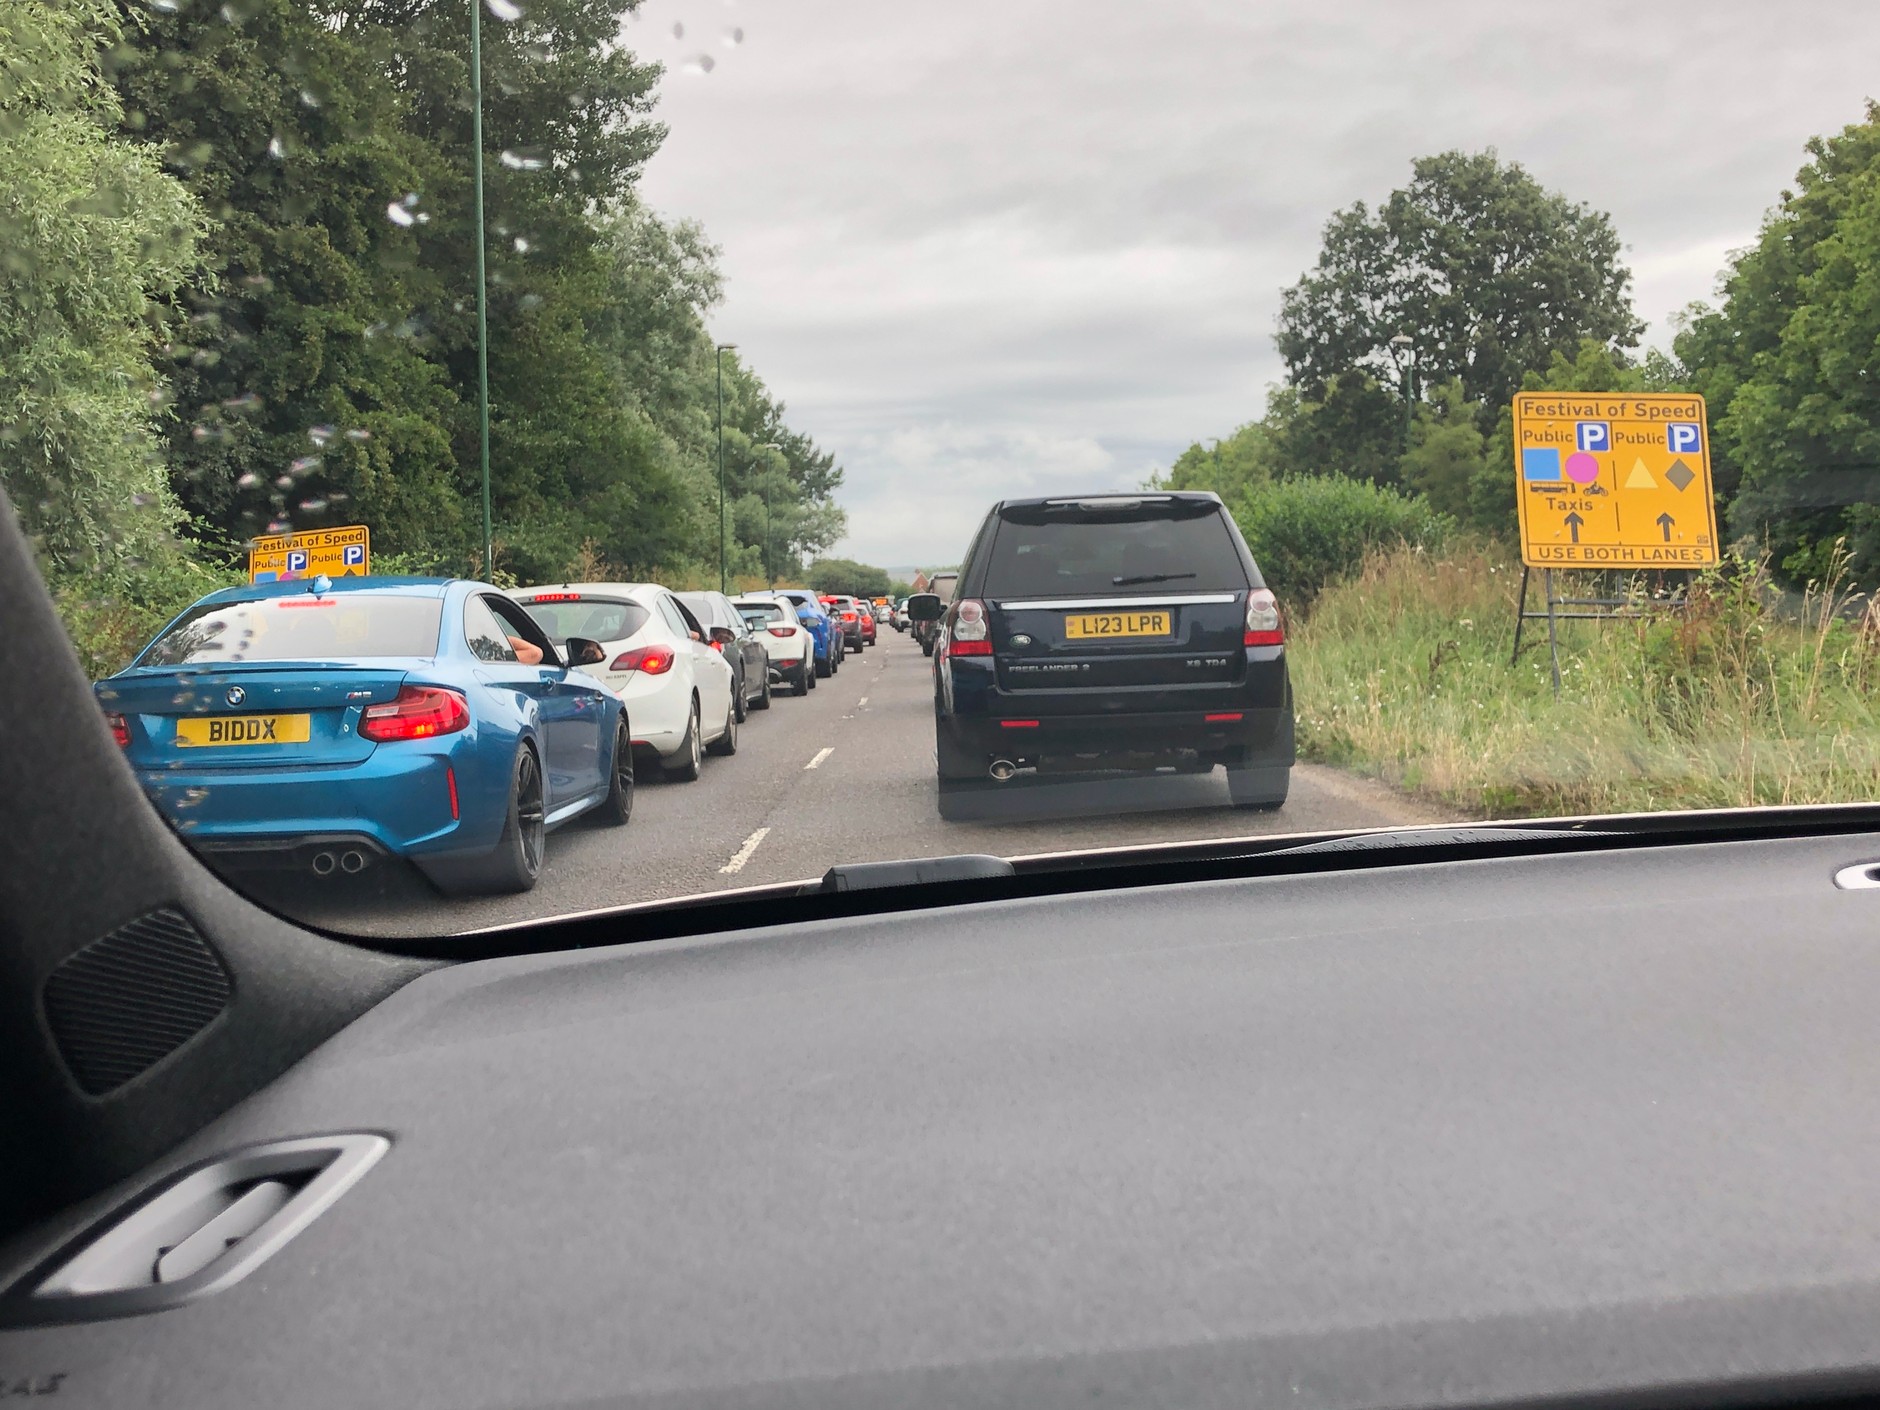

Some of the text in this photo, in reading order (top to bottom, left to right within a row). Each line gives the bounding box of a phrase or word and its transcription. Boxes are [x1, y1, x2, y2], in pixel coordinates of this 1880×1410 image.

[1523, 401, 1697, 420] Festival of Speed
[1523, 424, 1605, 450] Public P
[1615, 425, 1696, 451] Public P
[1545, 497, 1593, 511] Taxis
[256, 531, 363, 552] Festival of Speed
[255, 553, 305, 571] Public P
[311, 546, 361, 565] Public P
[1538, 546, 1704, 561] USE BOTH LANES
[1082, 615, 1163, 634] L123 LPR
[1008, 663, 1079, 673] FREELANDER
